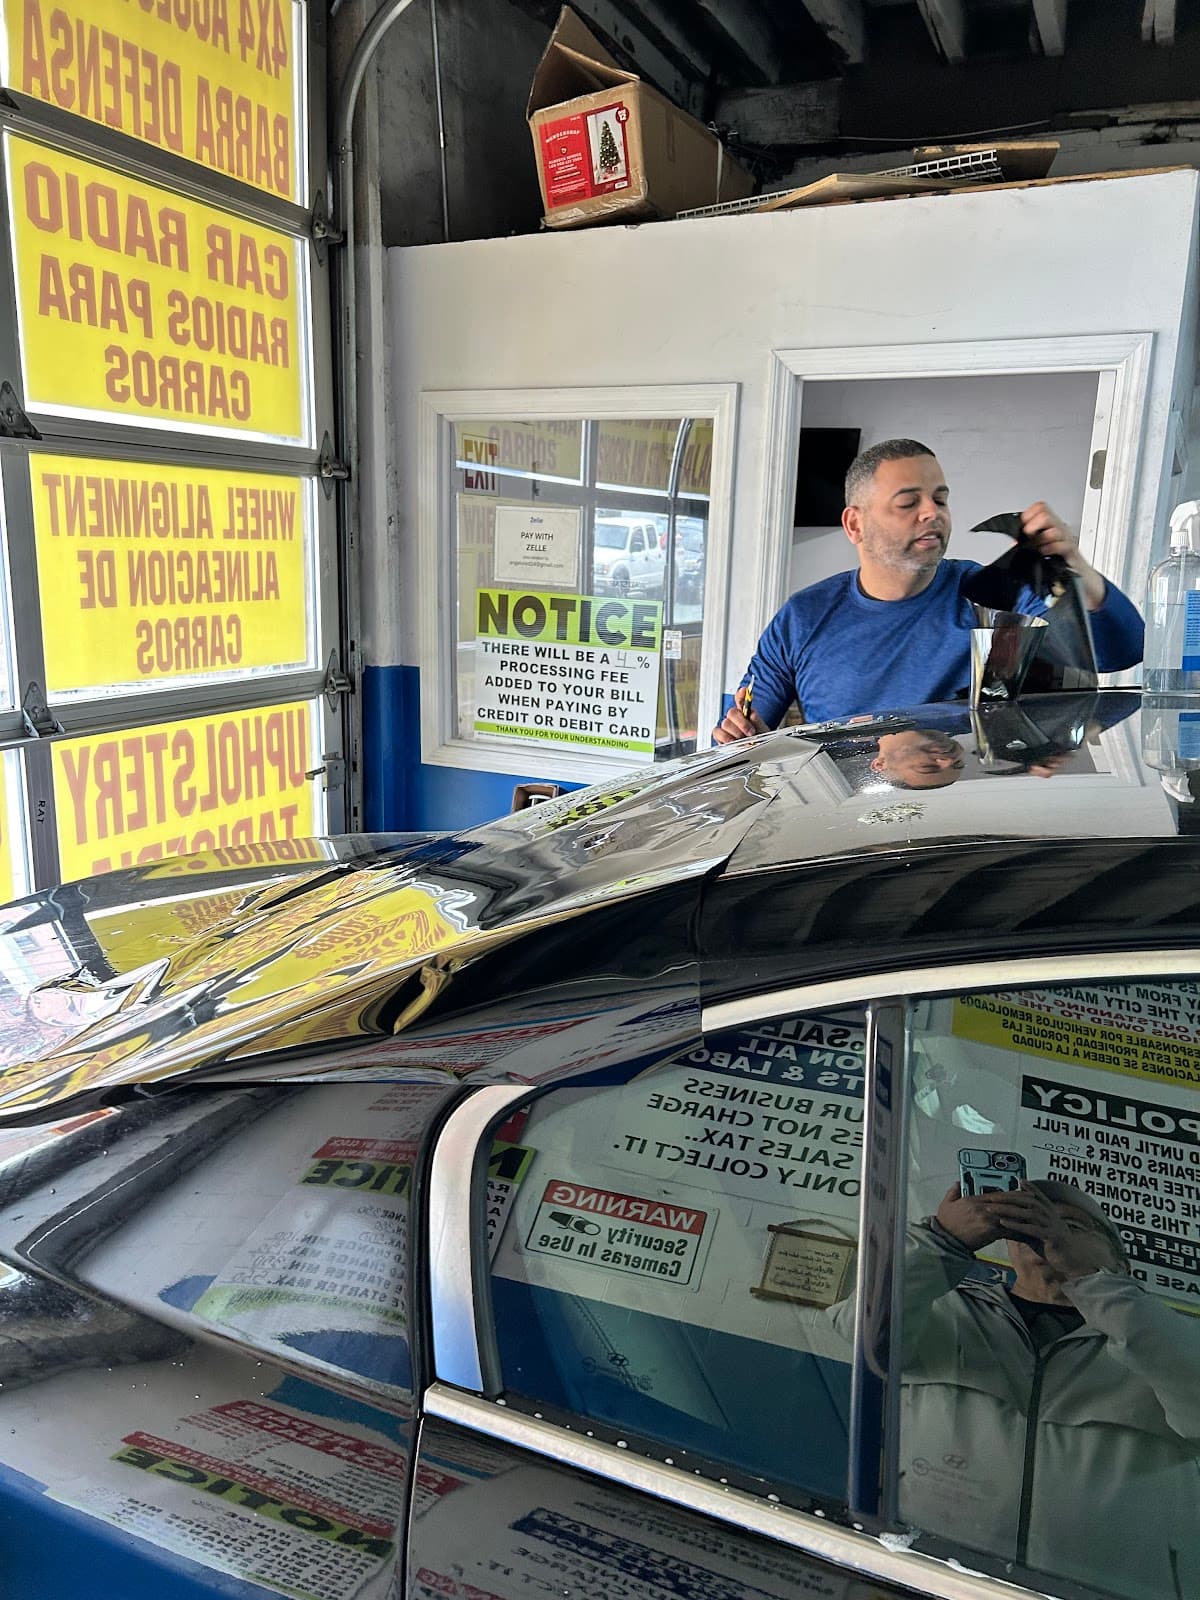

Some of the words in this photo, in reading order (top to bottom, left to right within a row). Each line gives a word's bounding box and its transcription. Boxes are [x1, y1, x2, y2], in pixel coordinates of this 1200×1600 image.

[464, 439, 497, 491] EXIT
[520, 531, 534, 540] PAY
[534, 532, 554, 541] WITH
[526, 544, 548, 552] ZELLE
[478, 592, 658, 649] NOTICE
[482, 641, 529, 656] THERE
[534, 646, 570, 660] WILL
[575, 651, 595, 662] BE
[600, 653, 610, 664] A
[500, 660, 595, 680] PROCESSING
[601, 670, 629, 684] FEE
[485, 676, 532, 690] ADDED
[538, 681, 557, 693] TO
[563, 684, 604, 699] YOUR
[610, 689, 644, 703] BILL
[498, 694, 540, 708] WHEN
[546, 699, 601, 715] PAYING
[608, 706, 628, 718] BY
[477, 707, 529, 723] CREDIT
[534, 714, 554, 726] OR
[559, 718, 604, 732] DEBIT
[609, 724, 651, 738] CARD
[496, 725, 519, 734] THANK
[519, 727, 534, 736] YOU
[535, 729, 549, 738] FOR
[550, 731, 569, 740] YOUR
[570, 735, 629, 749] UNDERSTANDING
